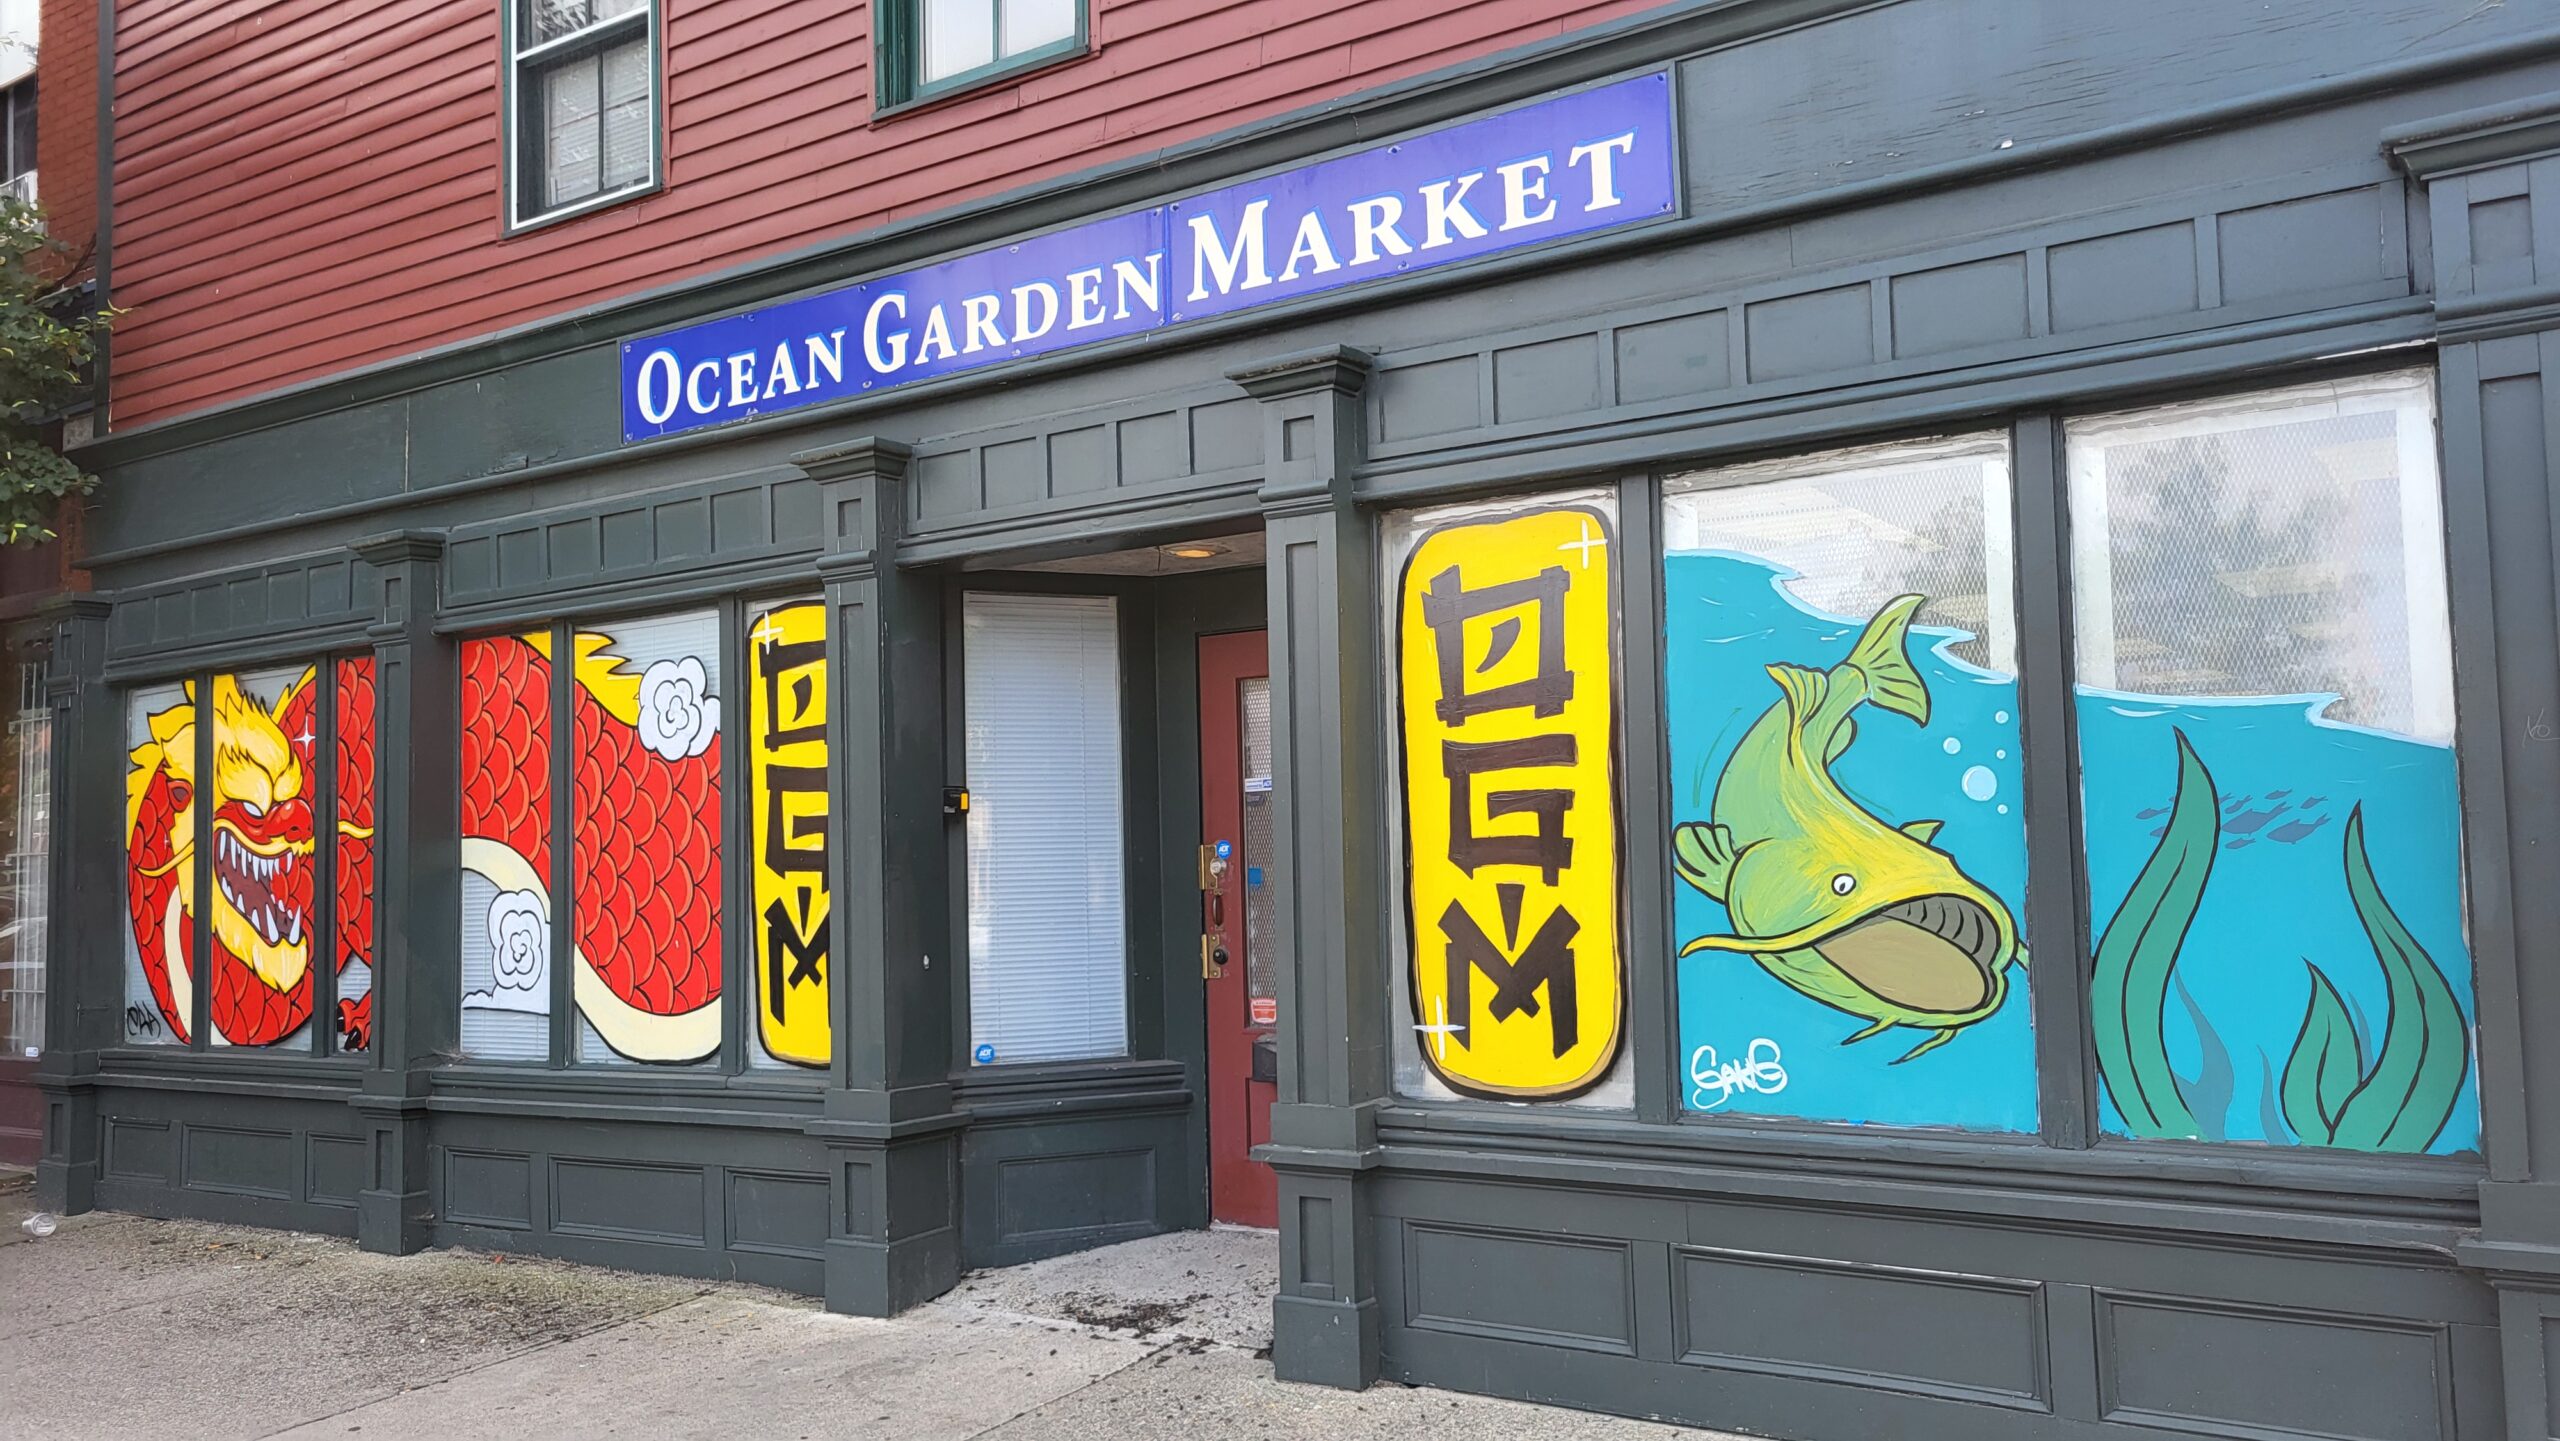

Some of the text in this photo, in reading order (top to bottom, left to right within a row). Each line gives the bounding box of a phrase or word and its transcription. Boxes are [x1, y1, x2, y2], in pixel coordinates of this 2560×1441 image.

[637, 127, 1638, 425] OCEAN GARDEN MARKET
